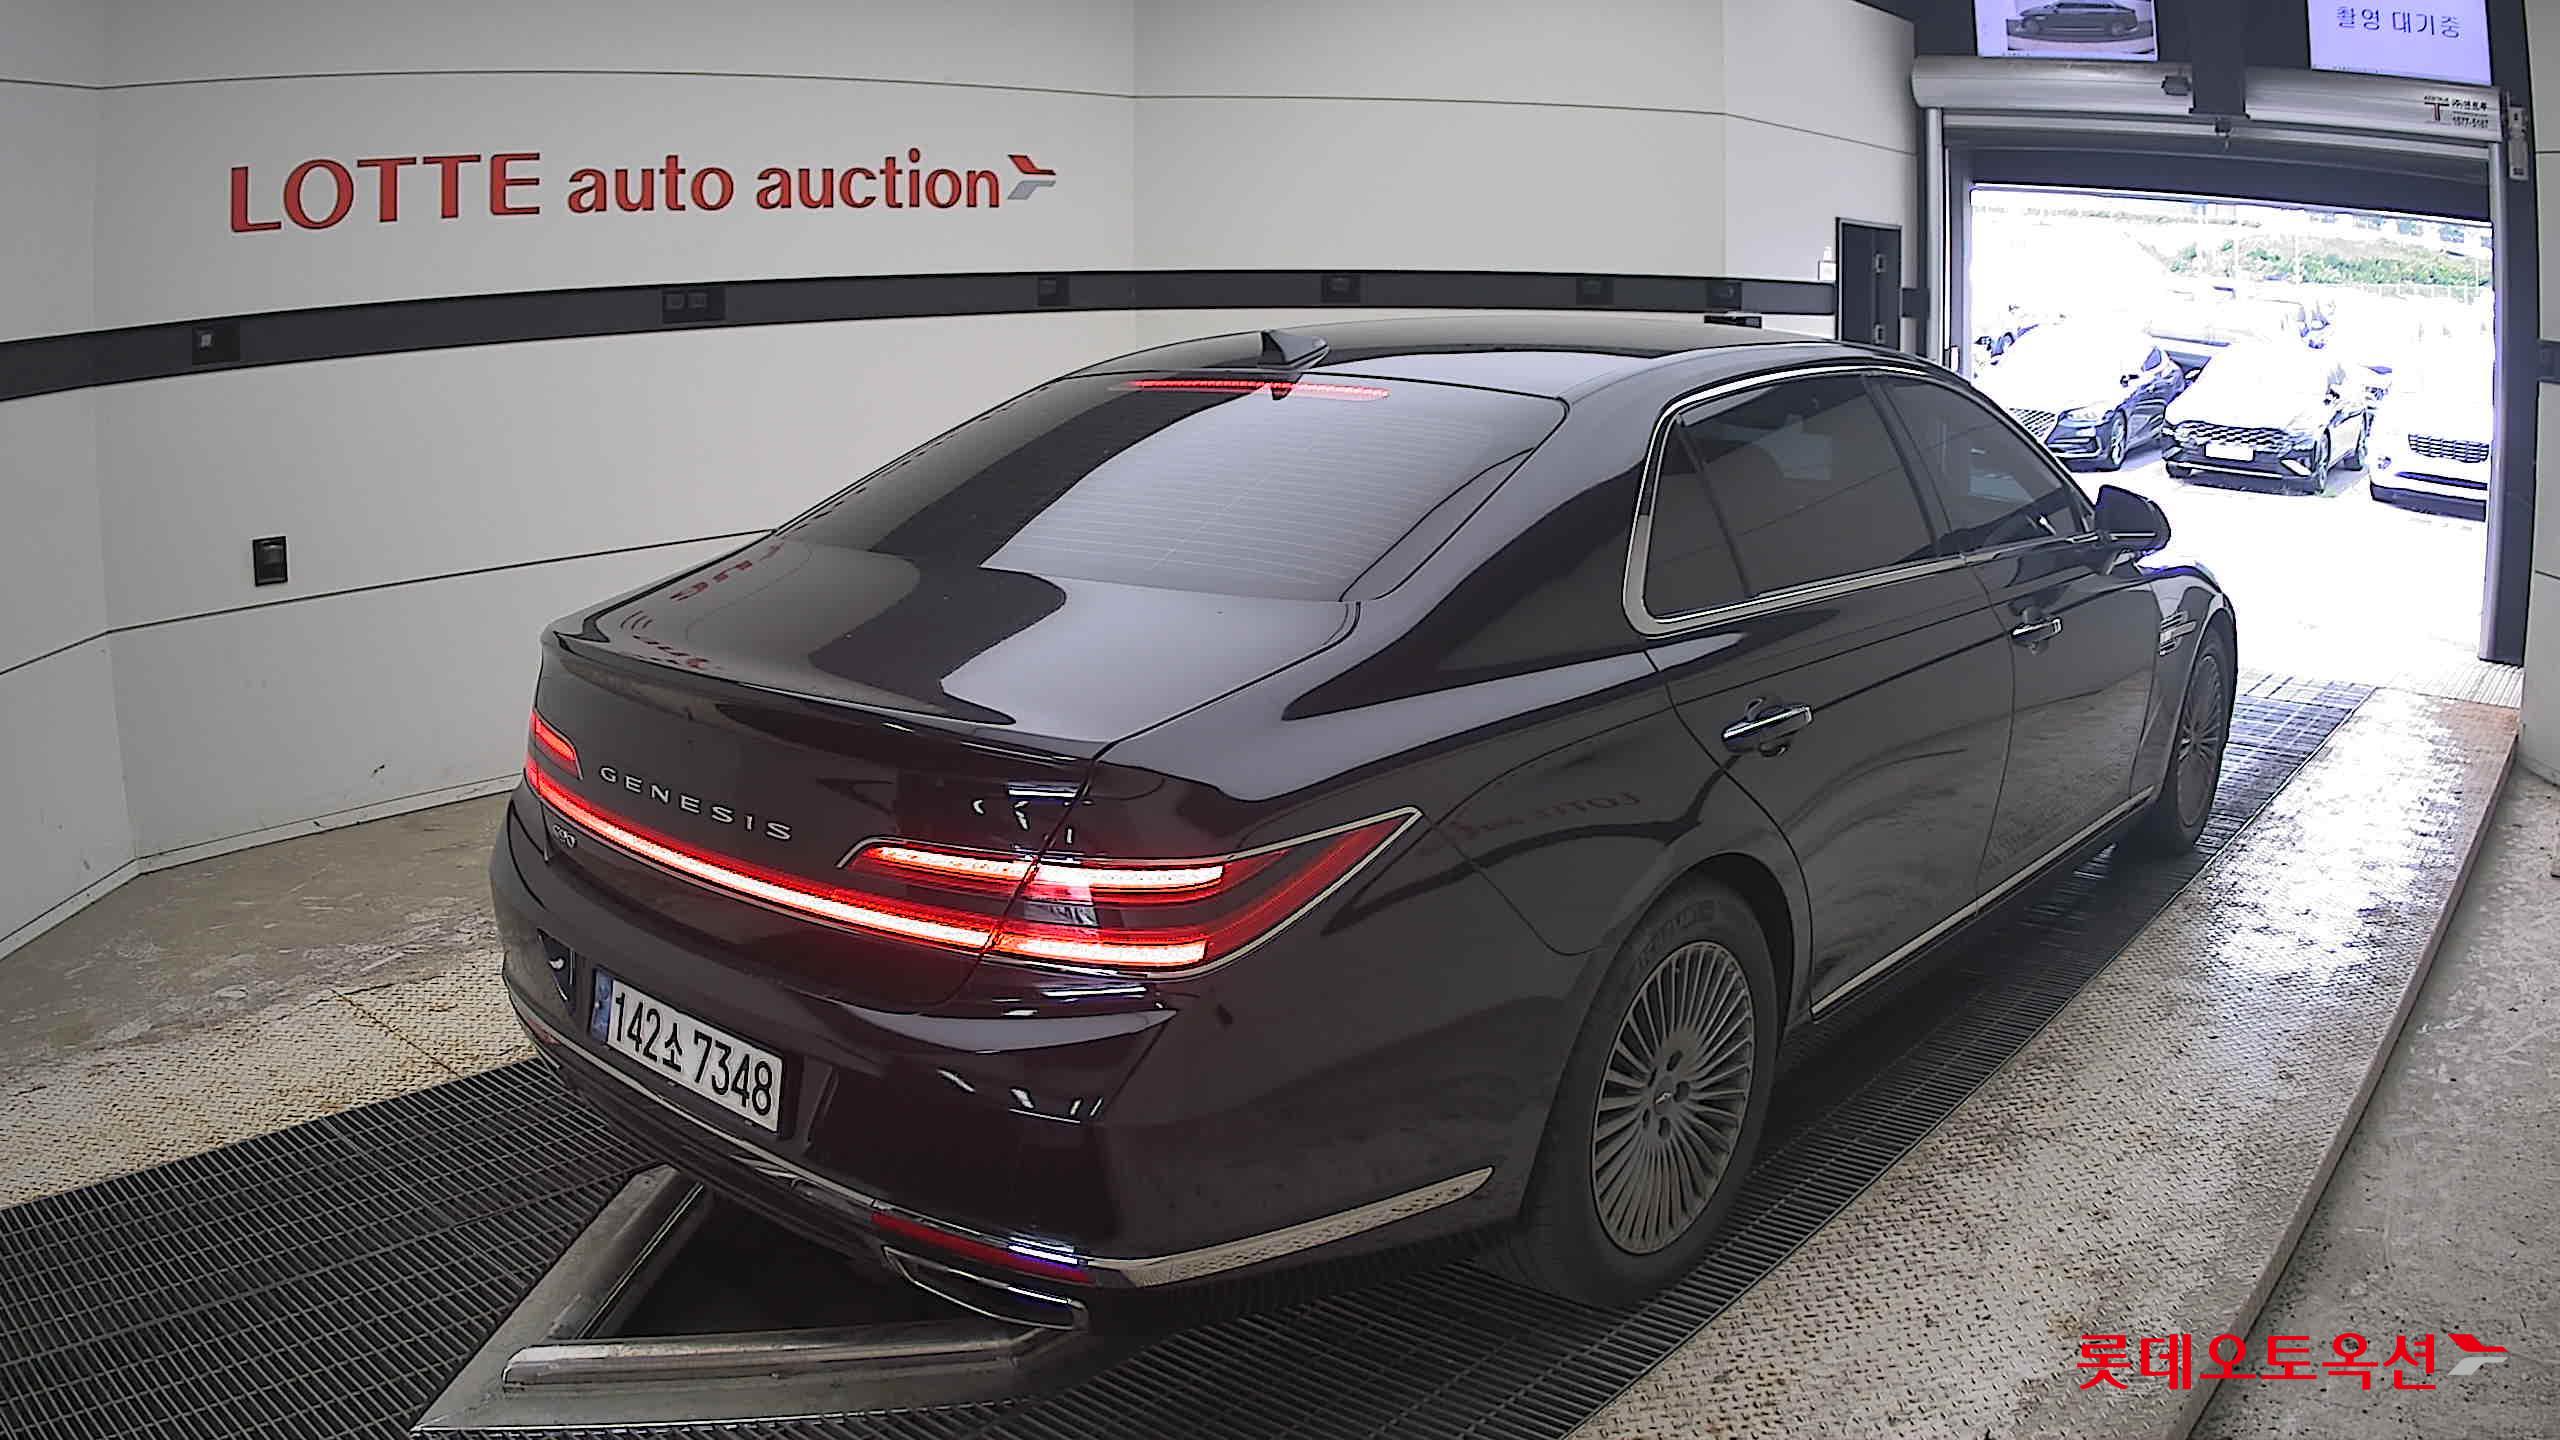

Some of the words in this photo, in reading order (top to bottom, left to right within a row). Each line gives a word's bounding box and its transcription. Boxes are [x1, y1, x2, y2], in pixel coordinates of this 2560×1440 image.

[2336, 6, 2380, 31] 촬영
[2391, 11, 2461, 39] 대기중
[230, 152, 541, 233] LOTTE
[567, 154, 734, 213] auto
[756, 147, 1001, 210] auction
[599, 766, 793, 841] GENESIS
